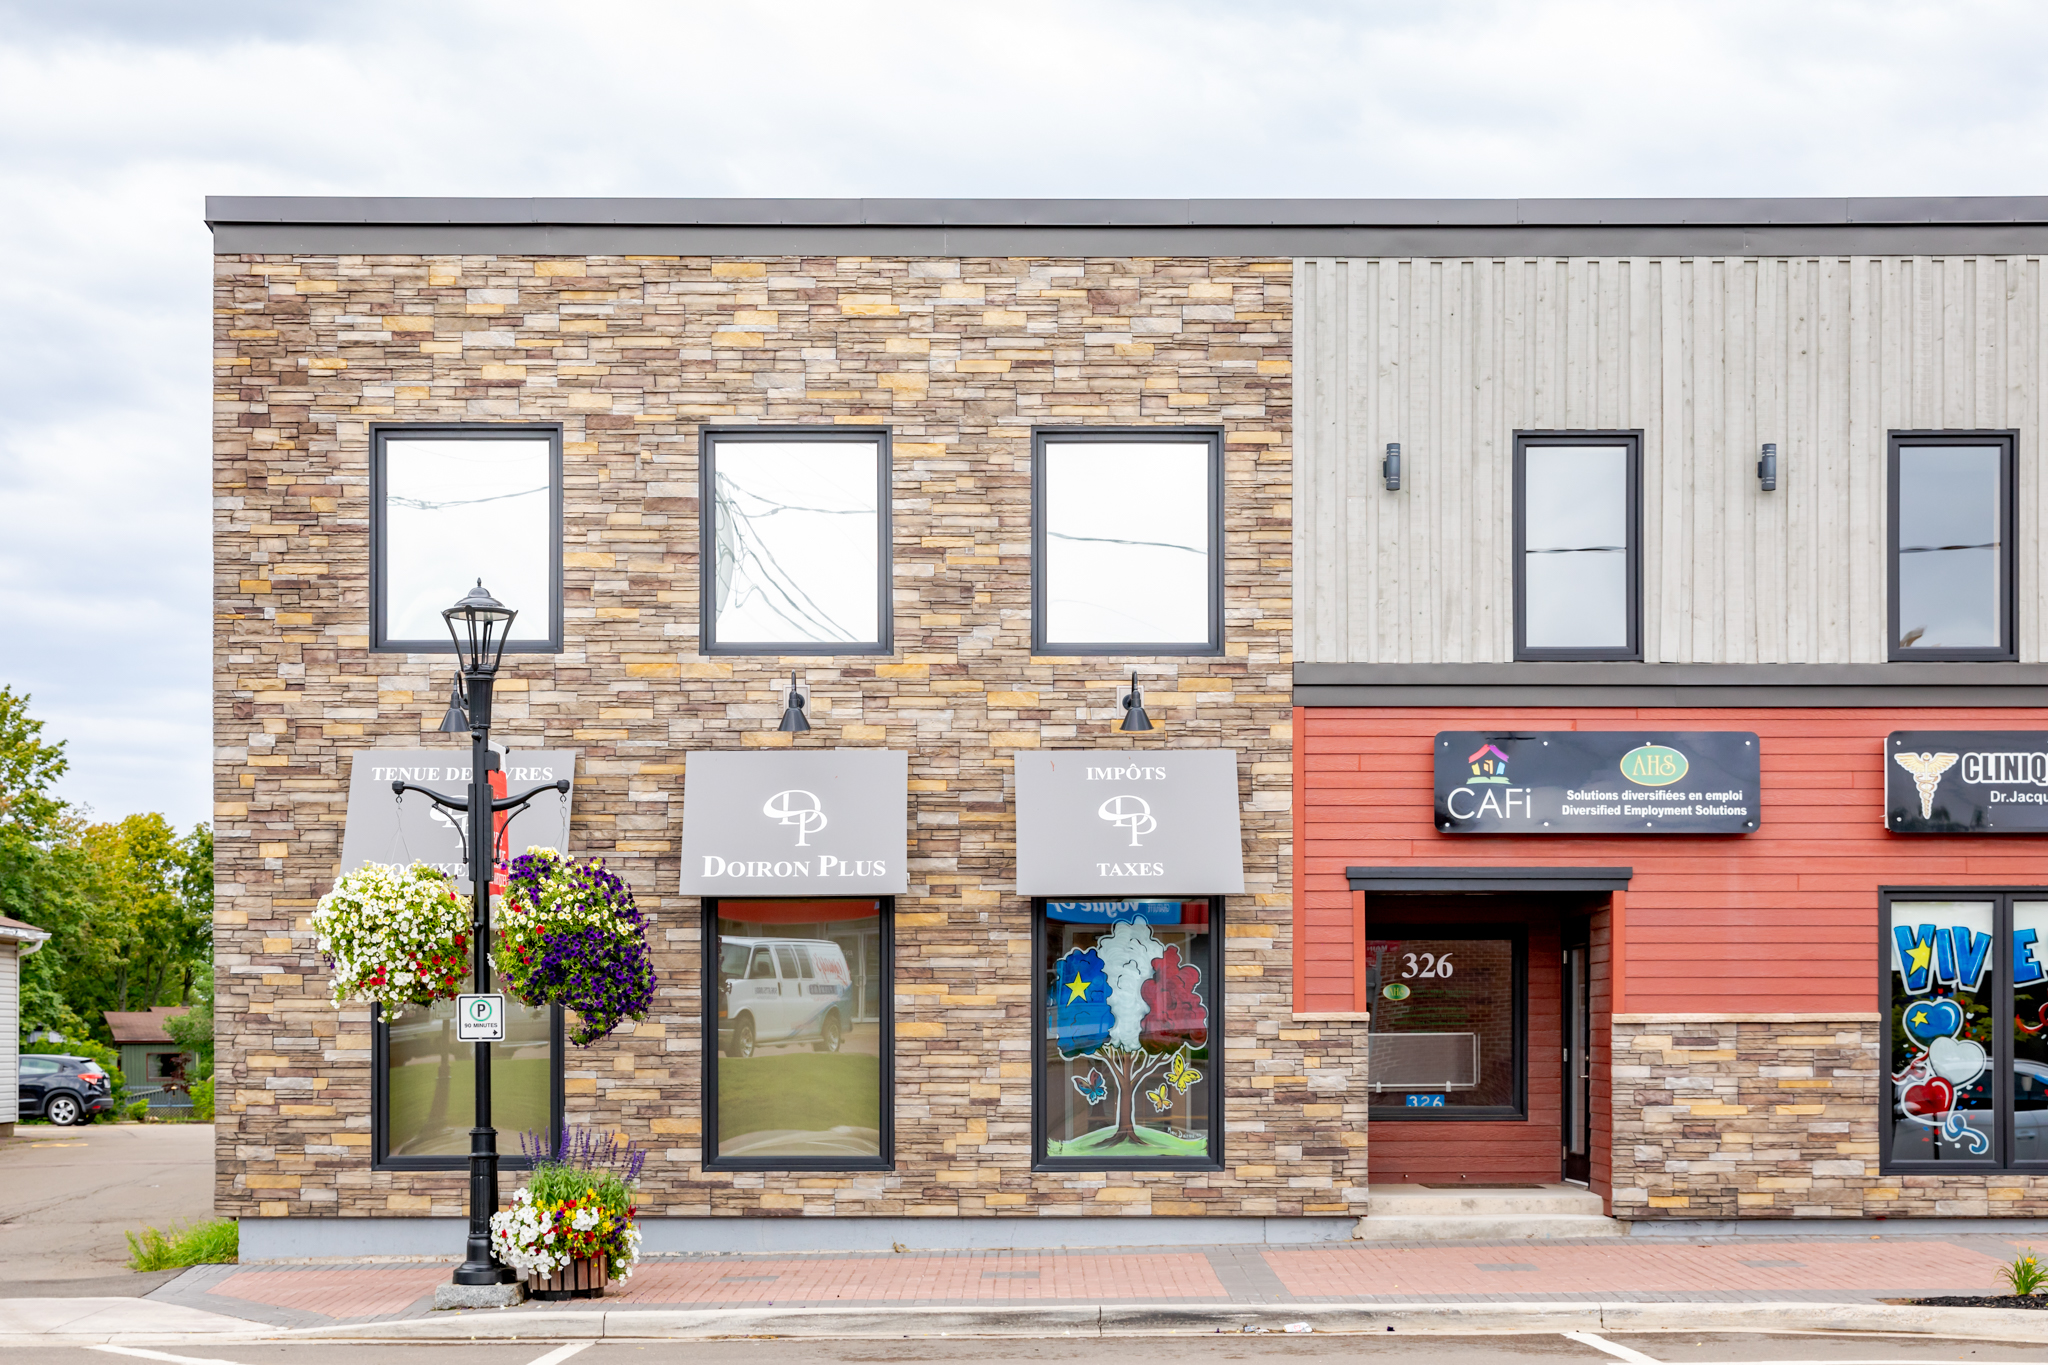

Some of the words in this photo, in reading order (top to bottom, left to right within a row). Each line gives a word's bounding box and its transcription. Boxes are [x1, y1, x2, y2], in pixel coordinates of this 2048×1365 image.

[371, 767, 441, 781] TENUE
[445, 767, 473, 781] DE
[1086, 764, 1167, 781] IMPÔTS
[1962, 752, 2048, 786] CLINIQ
[1566, 789, 1619, 801] Solutions
[1621, 789, 1686, 801] diversifiées
[1689, 791, 1702, 801] en
[1705, 789, 1743, 802] emploi
[1562, 804, 1621, 816] Diversified
[1624, 804, 1693, 818] Employment
[1695, 804, 1748, 816] Solutions
[1096, 862, 1165, 877] TAXES
[1401, 952, 1454, 979] 326
[1408, 1095, 1443, 1107] 326
